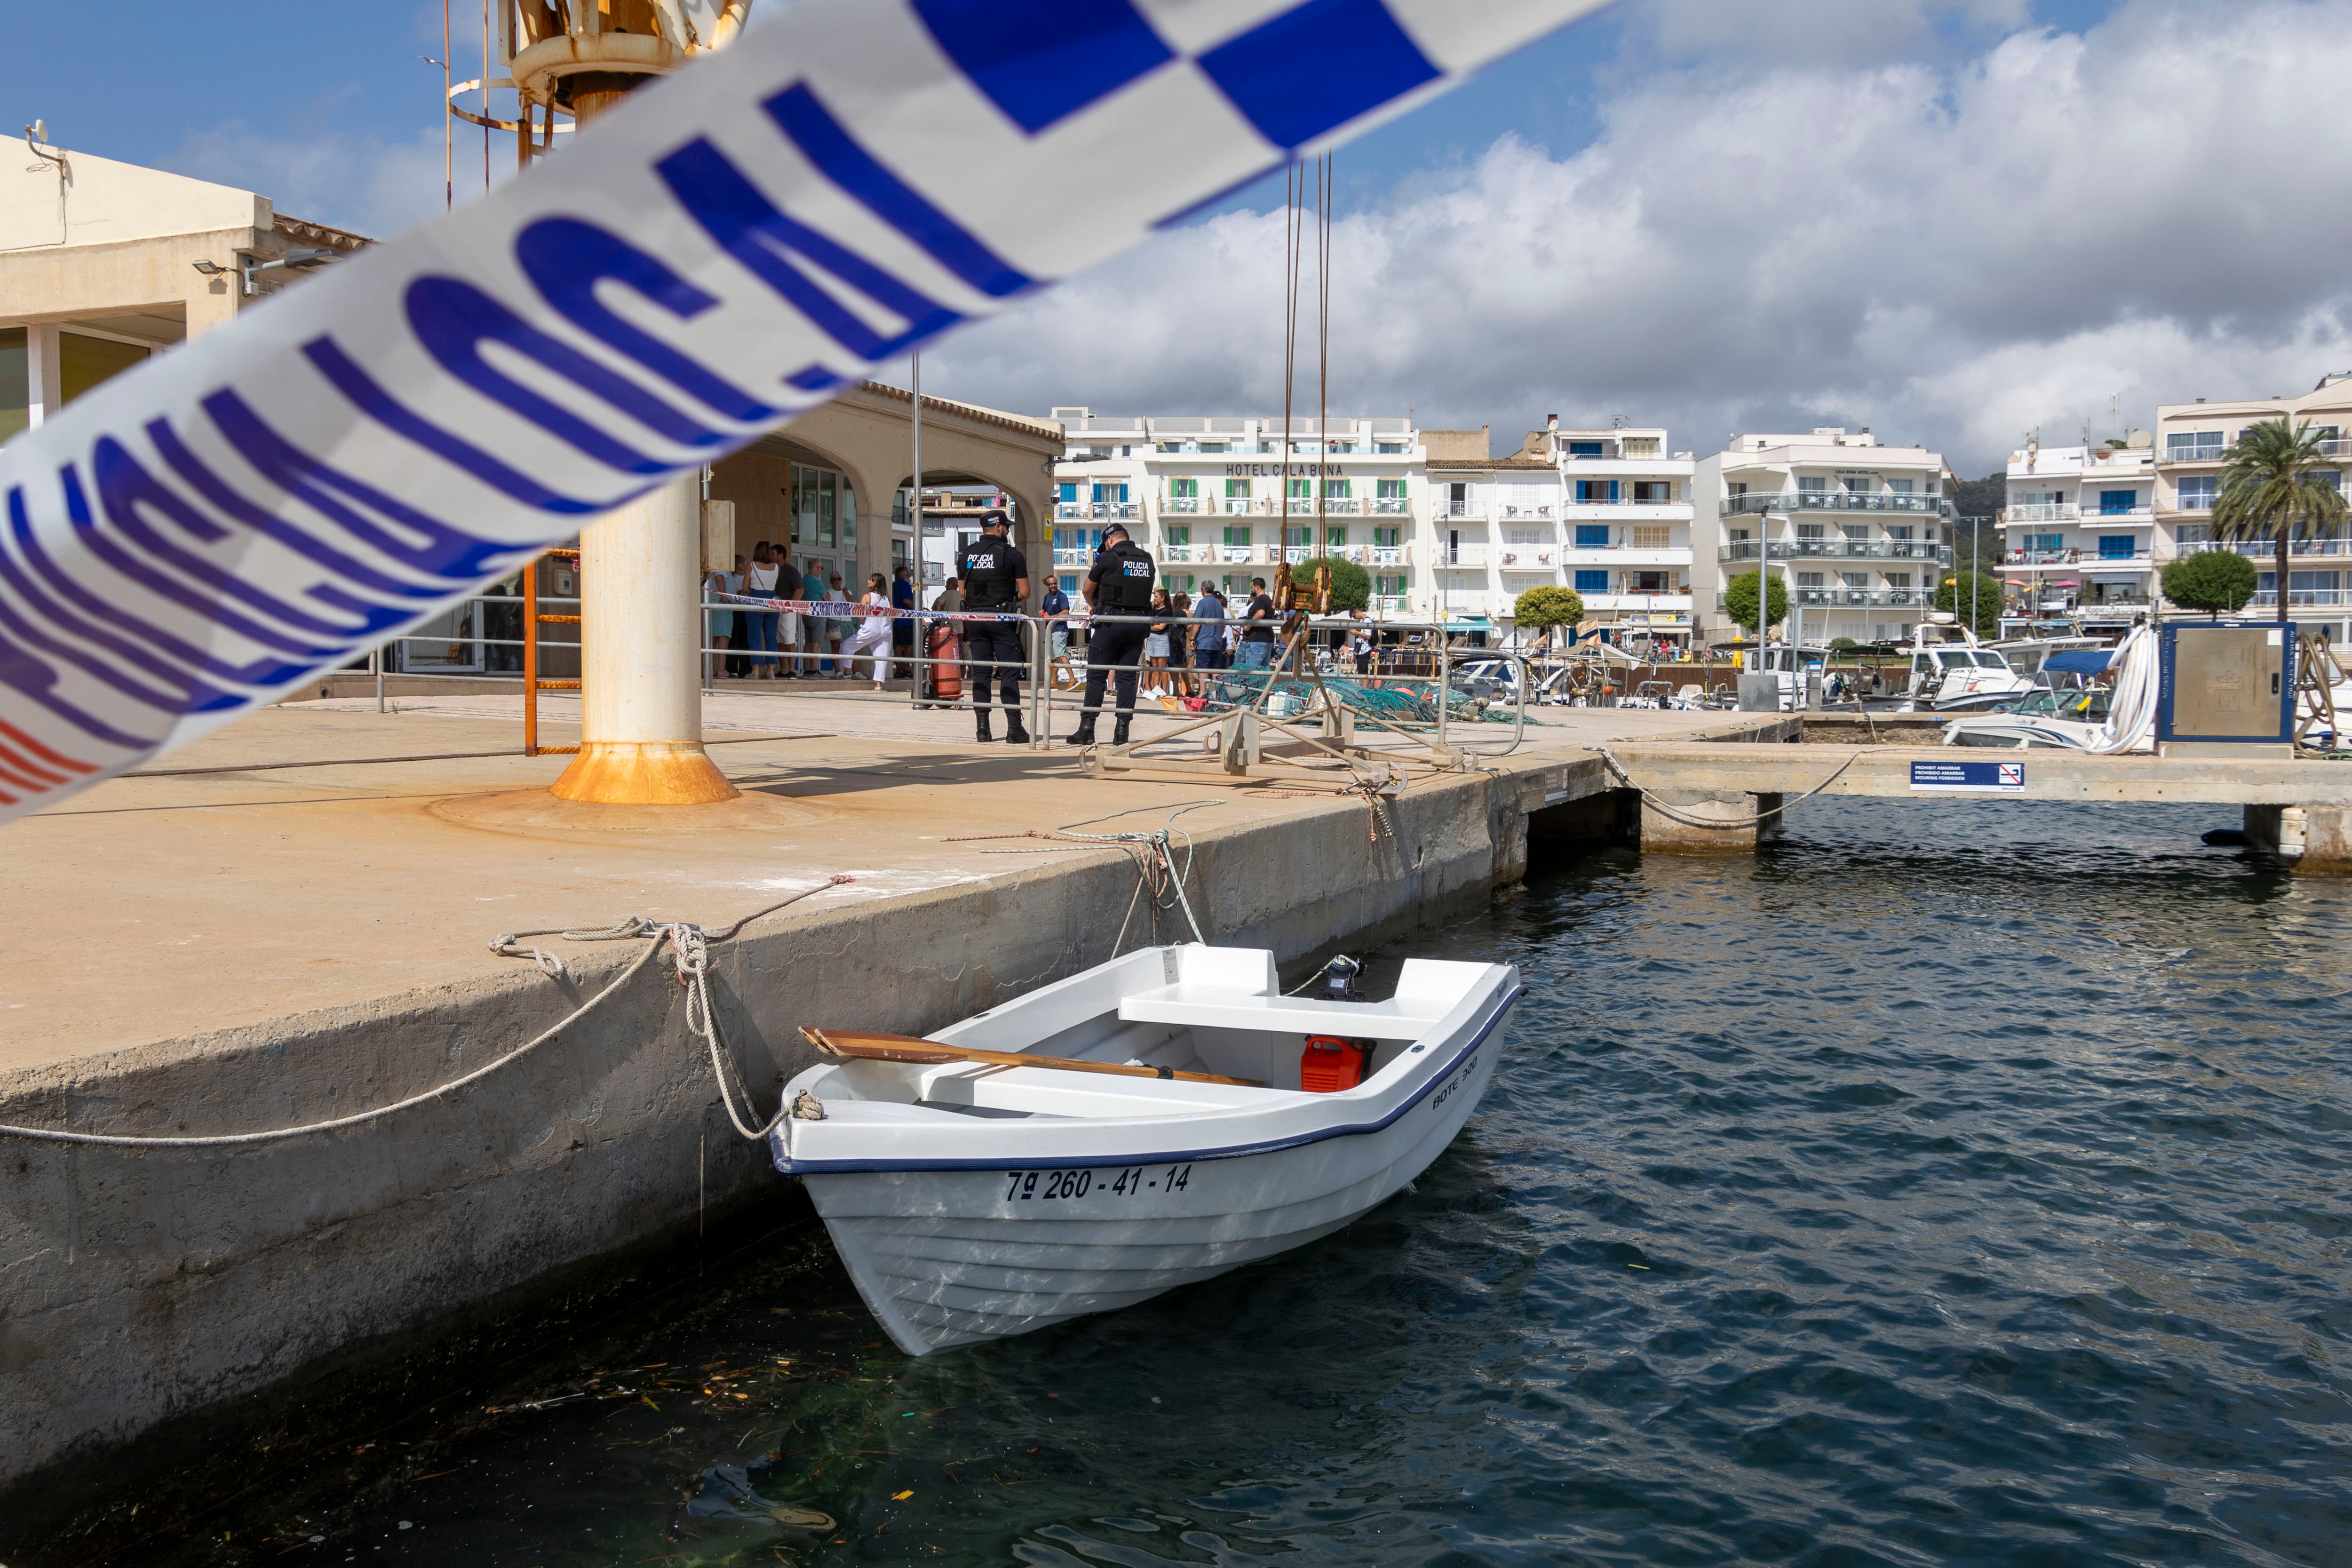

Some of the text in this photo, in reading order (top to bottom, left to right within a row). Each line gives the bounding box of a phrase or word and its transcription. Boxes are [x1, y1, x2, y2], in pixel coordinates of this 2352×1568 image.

[303, 78, 1056, 517] LOCAL
[1226, 464, 1267, 476] HOTEL
[1123, 561, 1148, 570] POLICIA
[1129, 569, 1150, 577] LOCAL
[819, 603, 834, 616] LOCAL
[834, 603, 852, 615] POLICIA
[2288, 657, 2294, 666] DE
[1433, 1056, 1478, 1110] BOTE 320
[1042, 1170, 1092, 1199] 260
[1112, 1167, 1143, 1196] 41
[1165, 1164, 1192, 1193] 14
